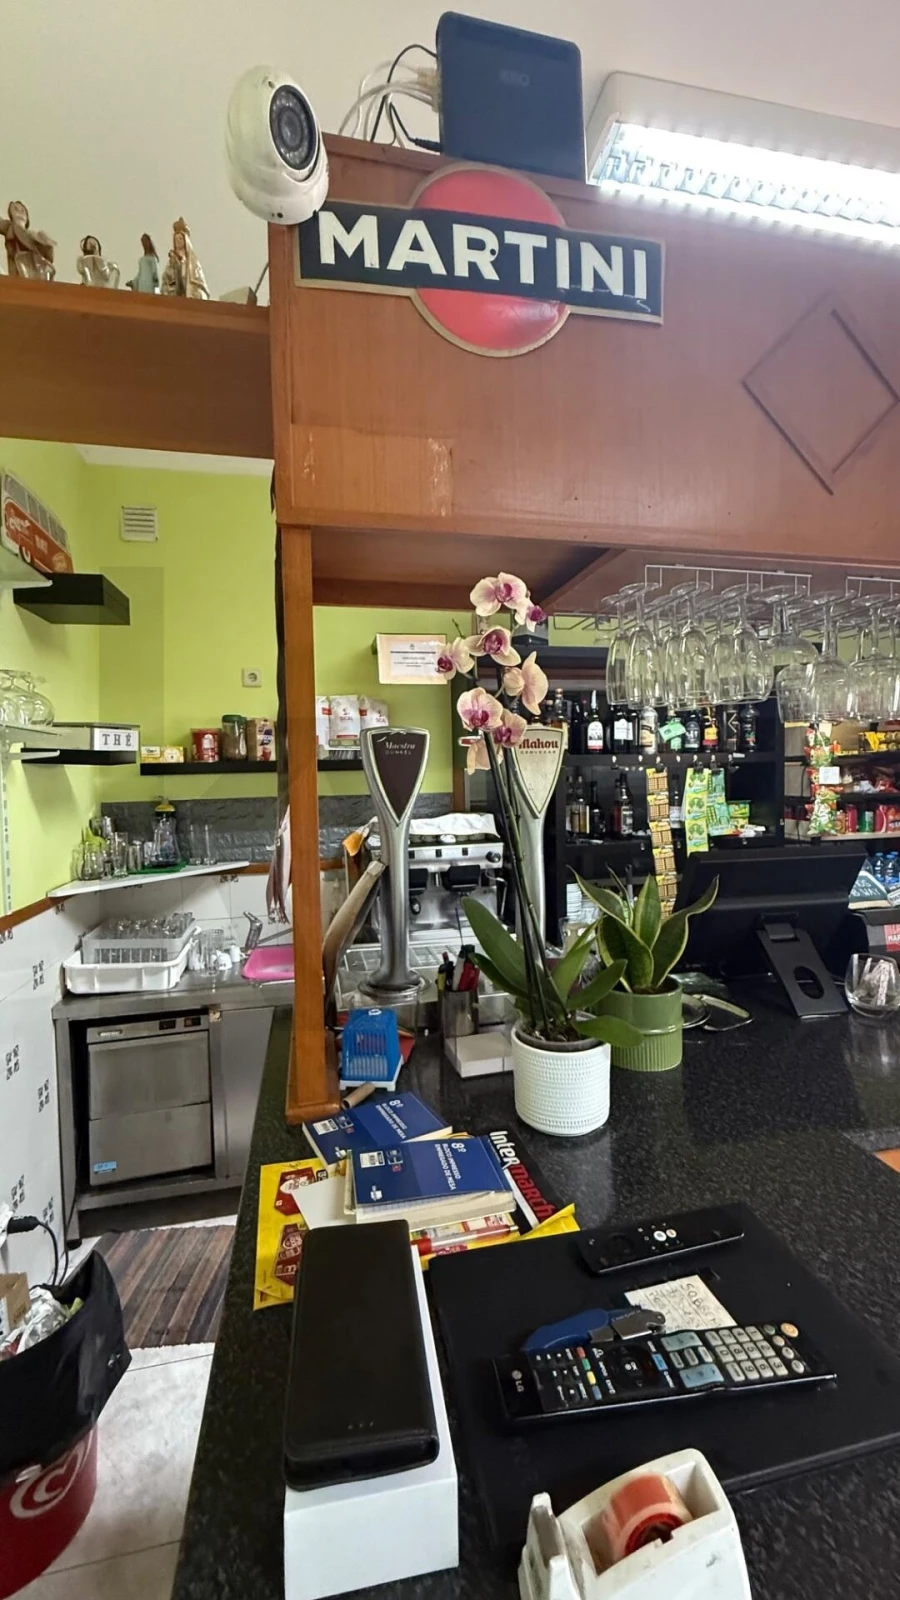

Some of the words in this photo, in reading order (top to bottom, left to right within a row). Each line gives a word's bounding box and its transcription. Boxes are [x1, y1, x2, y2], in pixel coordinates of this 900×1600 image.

[318, 210, 648, 301] MARTINI
[446, 1176, 457, 1190] MESA
[515, 1381, 525, 1392] LG
